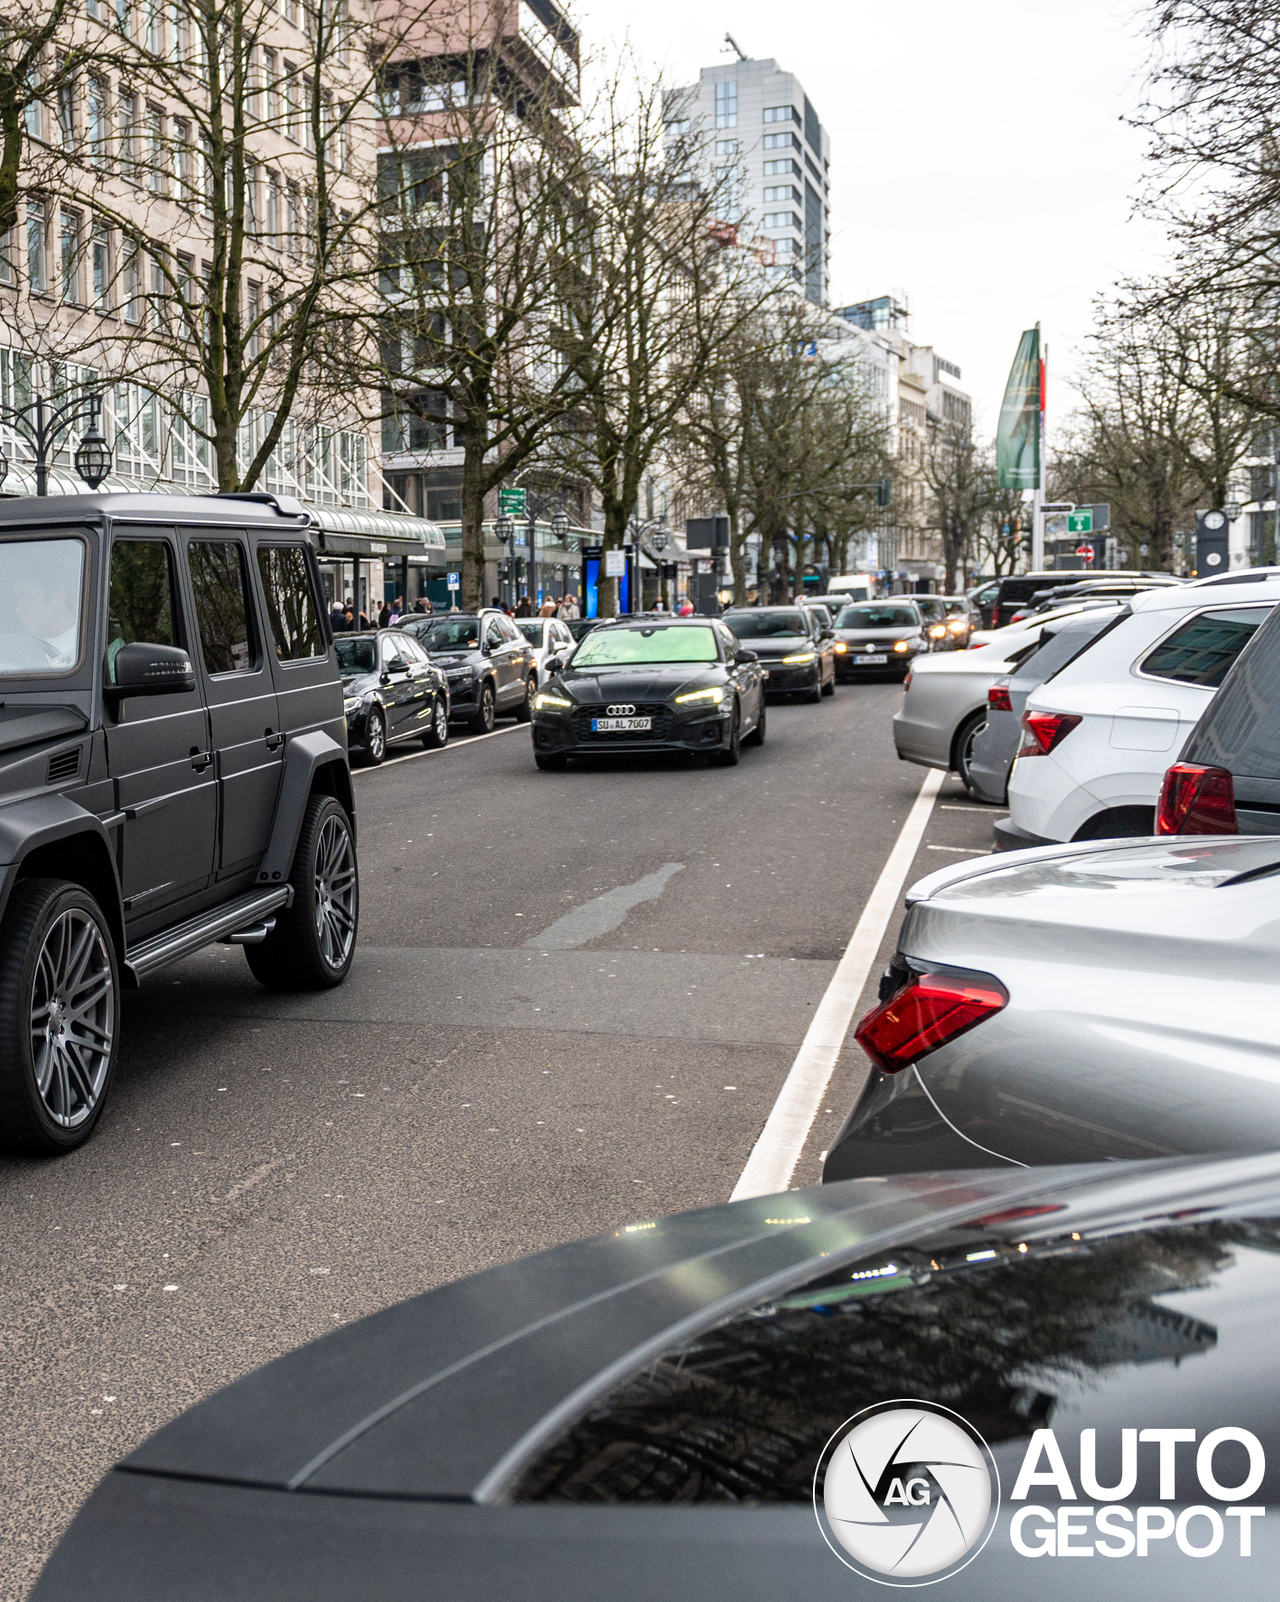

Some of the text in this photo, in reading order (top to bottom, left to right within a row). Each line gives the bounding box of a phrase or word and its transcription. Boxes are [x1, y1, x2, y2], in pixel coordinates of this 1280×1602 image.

[597, 719, 650, 730] SU AL 7007
